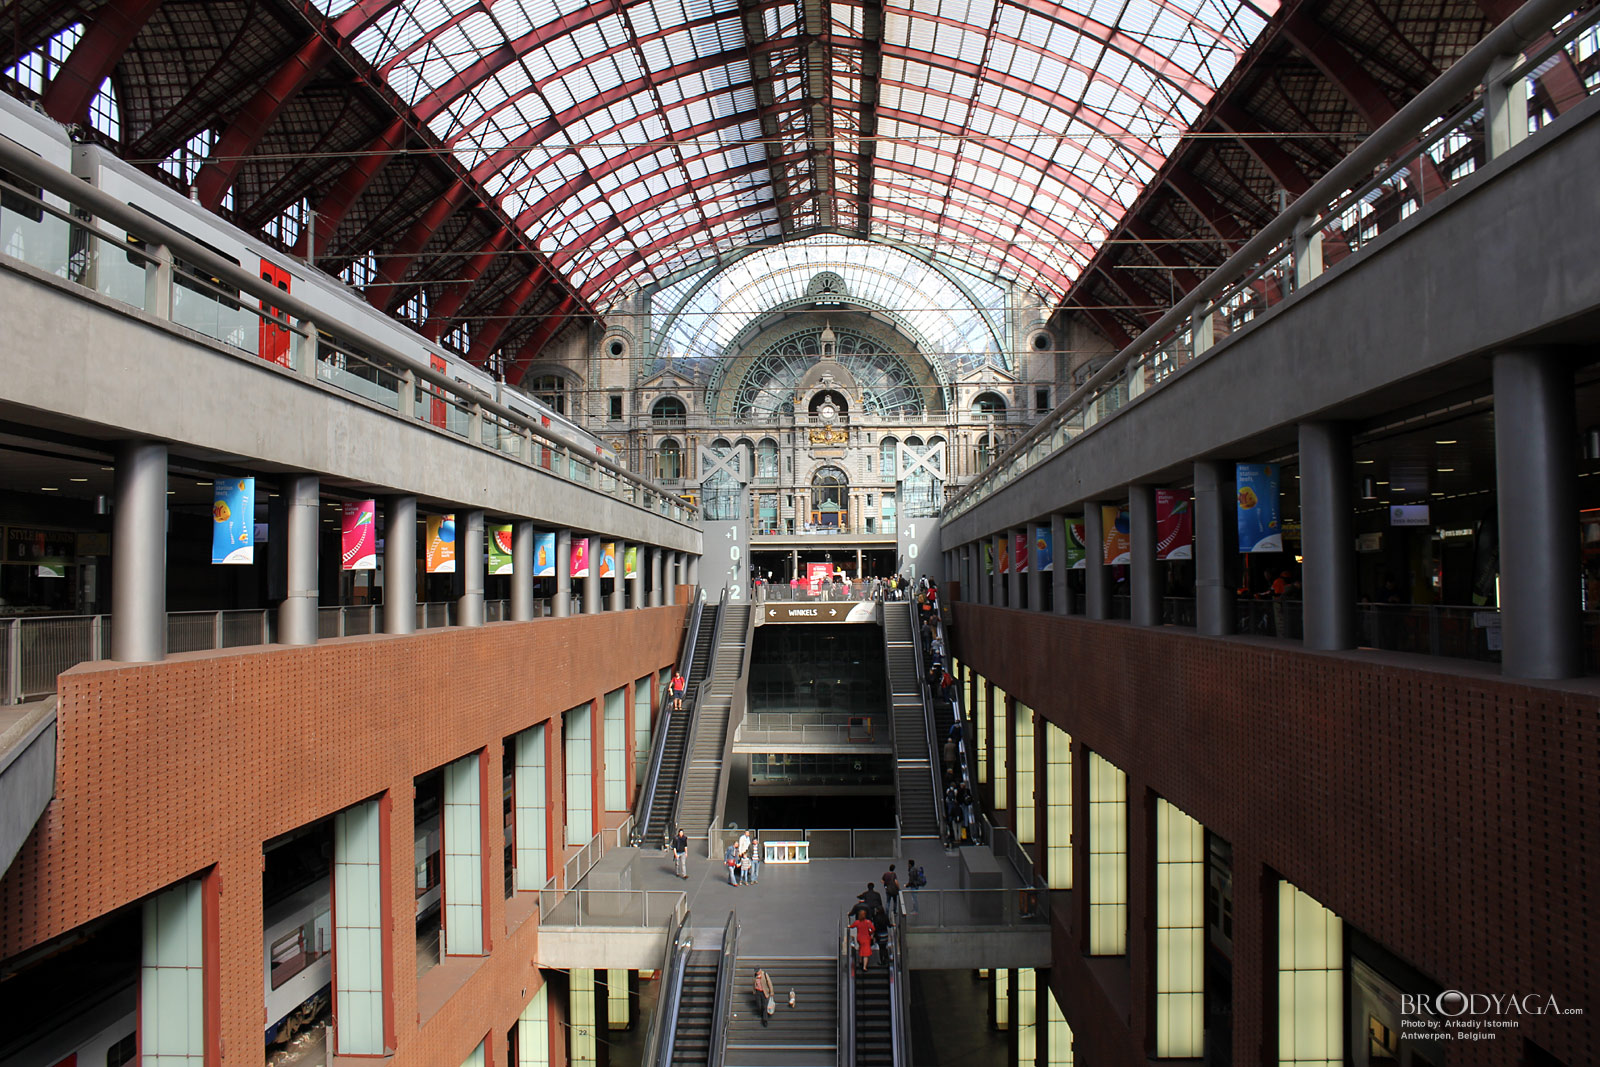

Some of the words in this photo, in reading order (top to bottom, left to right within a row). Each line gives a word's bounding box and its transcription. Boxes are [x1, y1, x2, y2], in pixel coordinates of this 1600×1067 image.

[9, 528, 34, 541] STYLE
[730, 545, 740, 561] 0
[908, 543, 919, 559] 0
[788, 608, 818, 617] WINKELS
